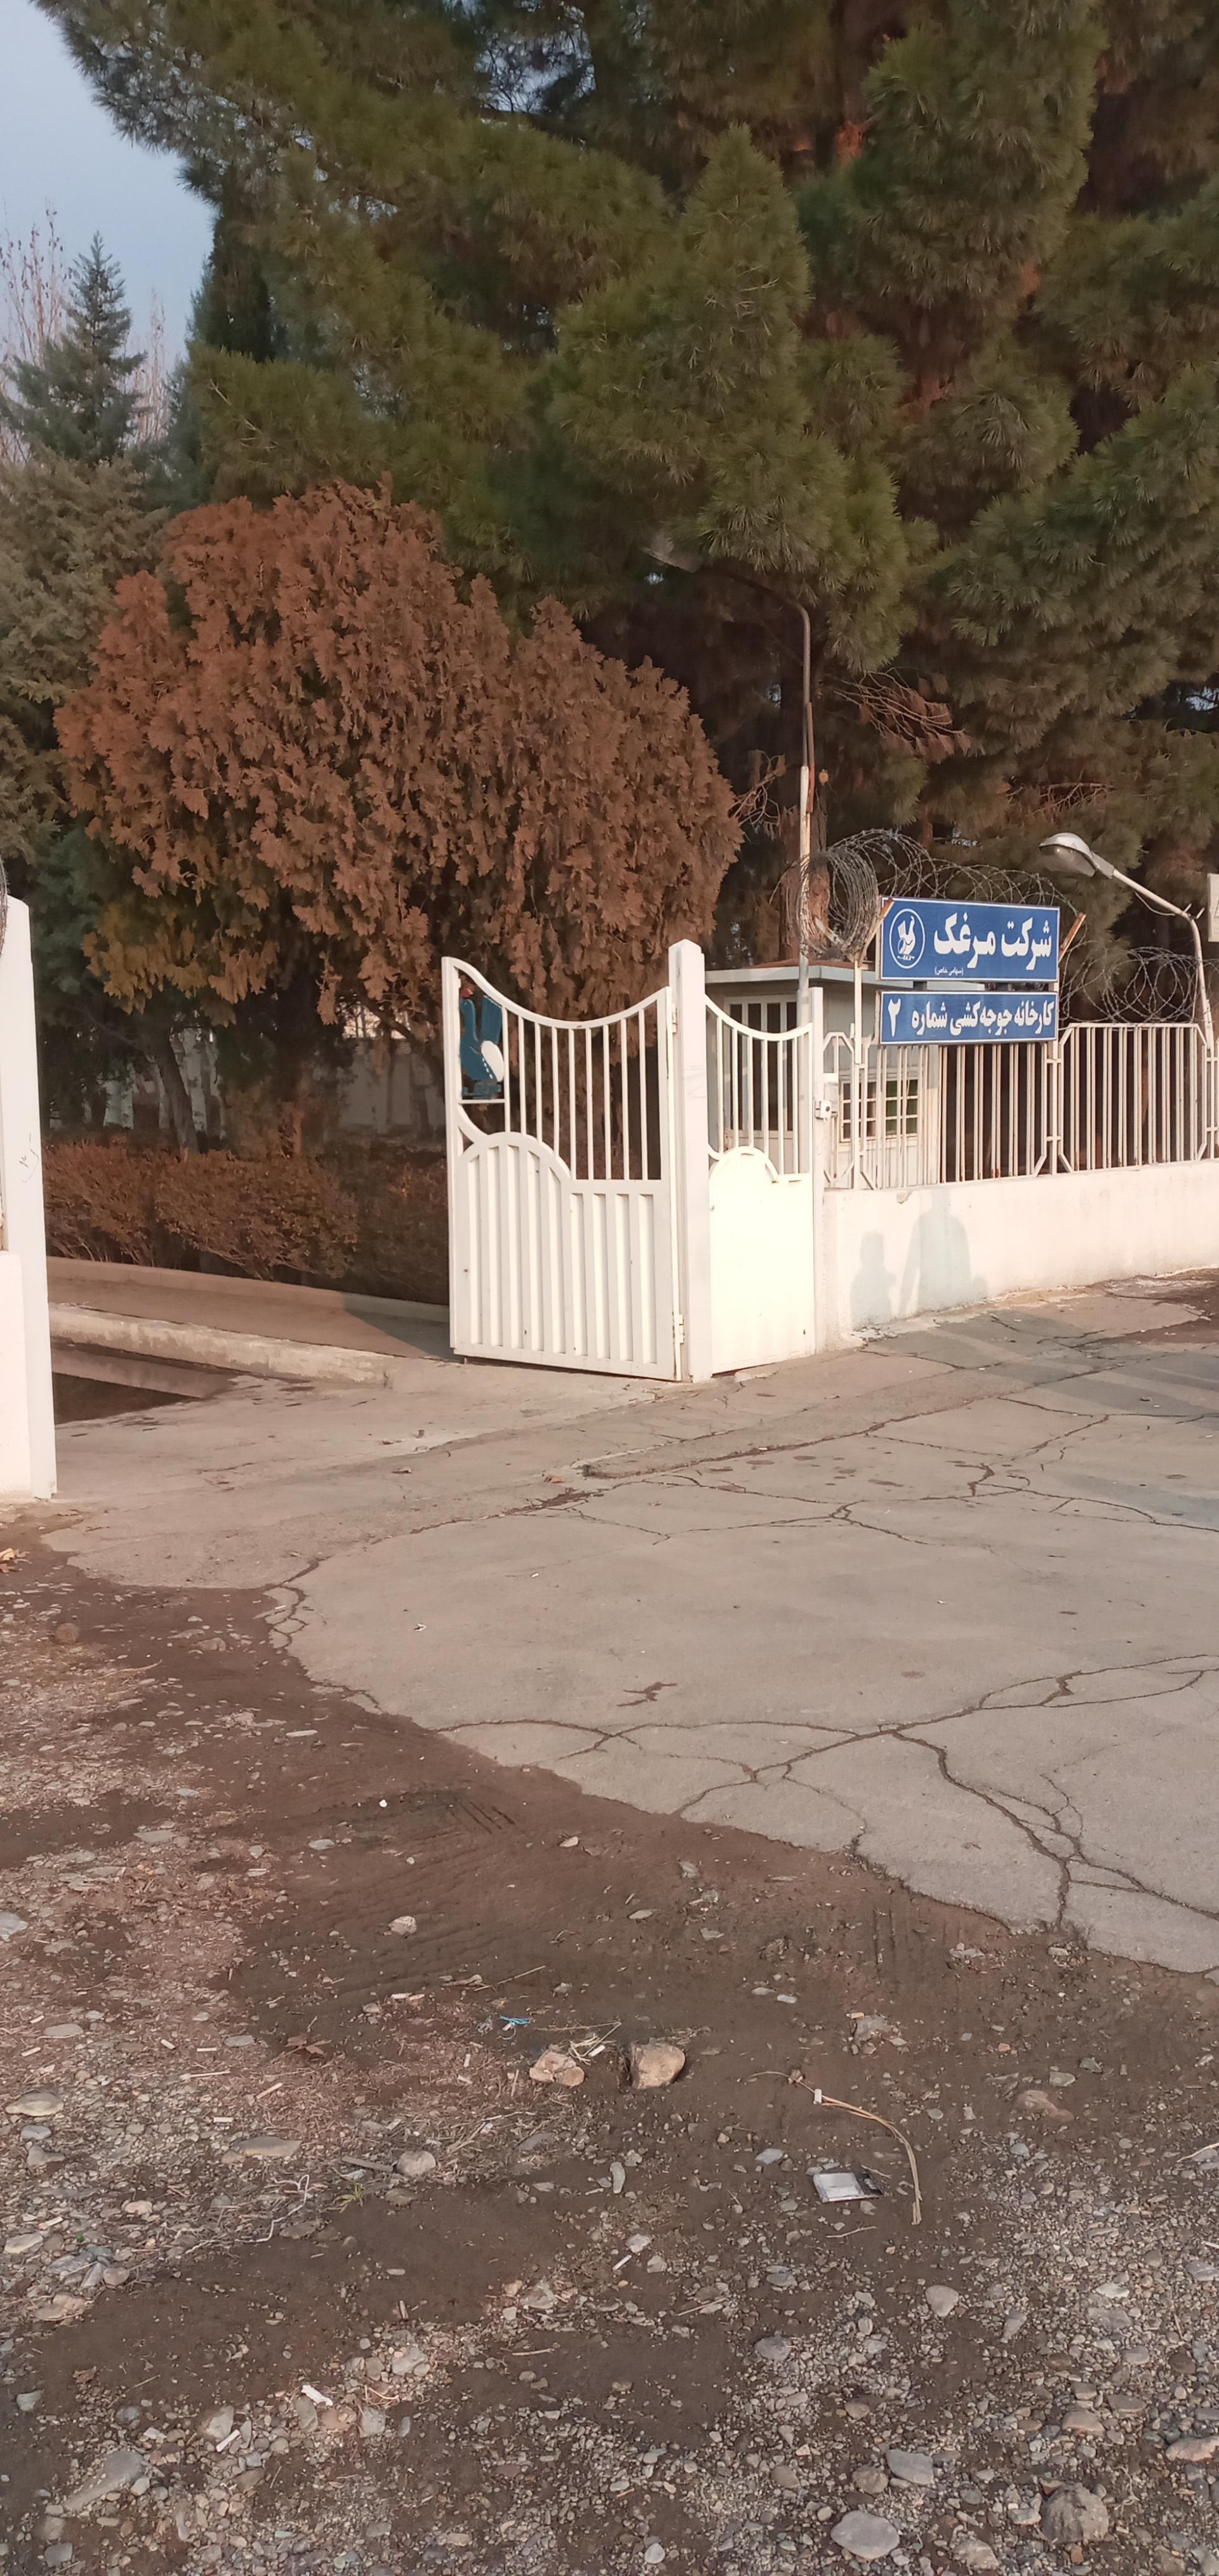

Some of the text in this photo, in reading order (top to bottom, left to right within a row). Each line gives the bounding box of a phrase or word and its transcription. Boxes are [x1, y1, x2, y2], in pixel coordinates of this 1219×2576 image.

[934, 912, 1052, 970] شرکت مرغک
[888, 998, 901, 1037] ۲
[912, 1001, 948, 1035] شماره
[1014, 1000, 1055, 1034] کارخانه
